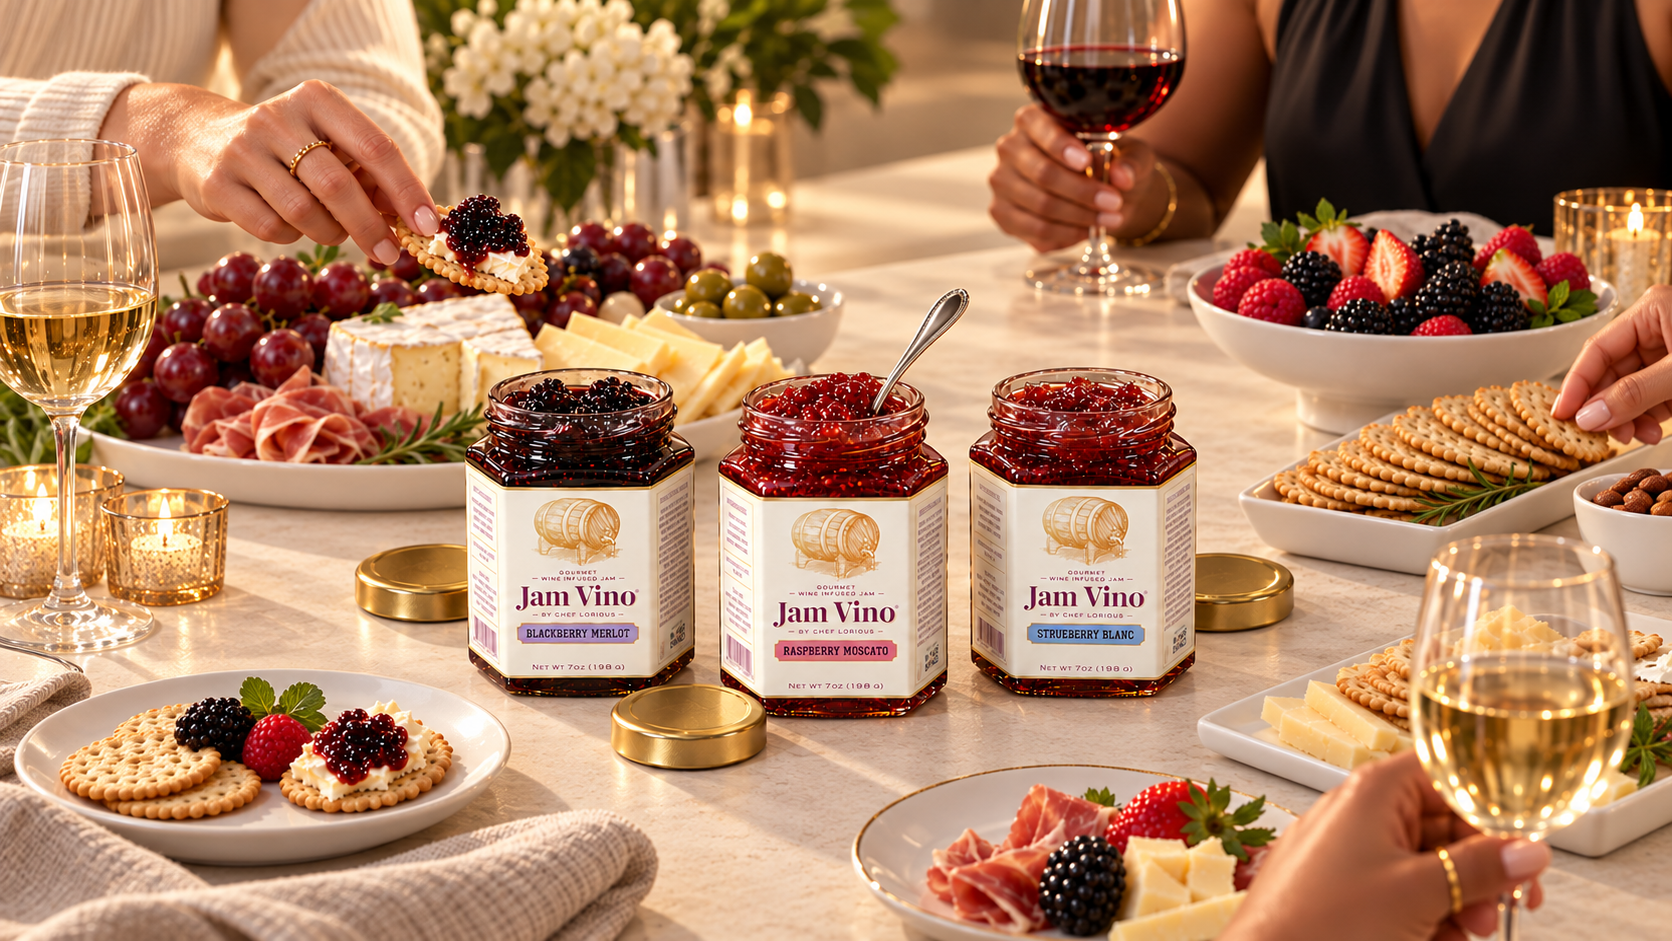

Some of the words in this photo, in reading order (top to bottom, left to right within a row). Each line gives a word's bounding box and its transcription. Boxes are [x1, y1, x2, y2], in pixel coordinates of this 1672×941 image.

[515, 586, 570, 611] Jam
[1023, 586, 1078, 611] Jam
[772, 602, 828, 628] Jam
[526, 629, 588, 639] BLACKBERRY
[591, 629, 630, 639] MERLOT
[1037, 629, 1100, 639] STRUEBERRY
[1102, 630, 1135, 640] BLANC
[783, 646, 840, 656] RASPBERRY
[843, 646, 889, 656] MOSCATO
